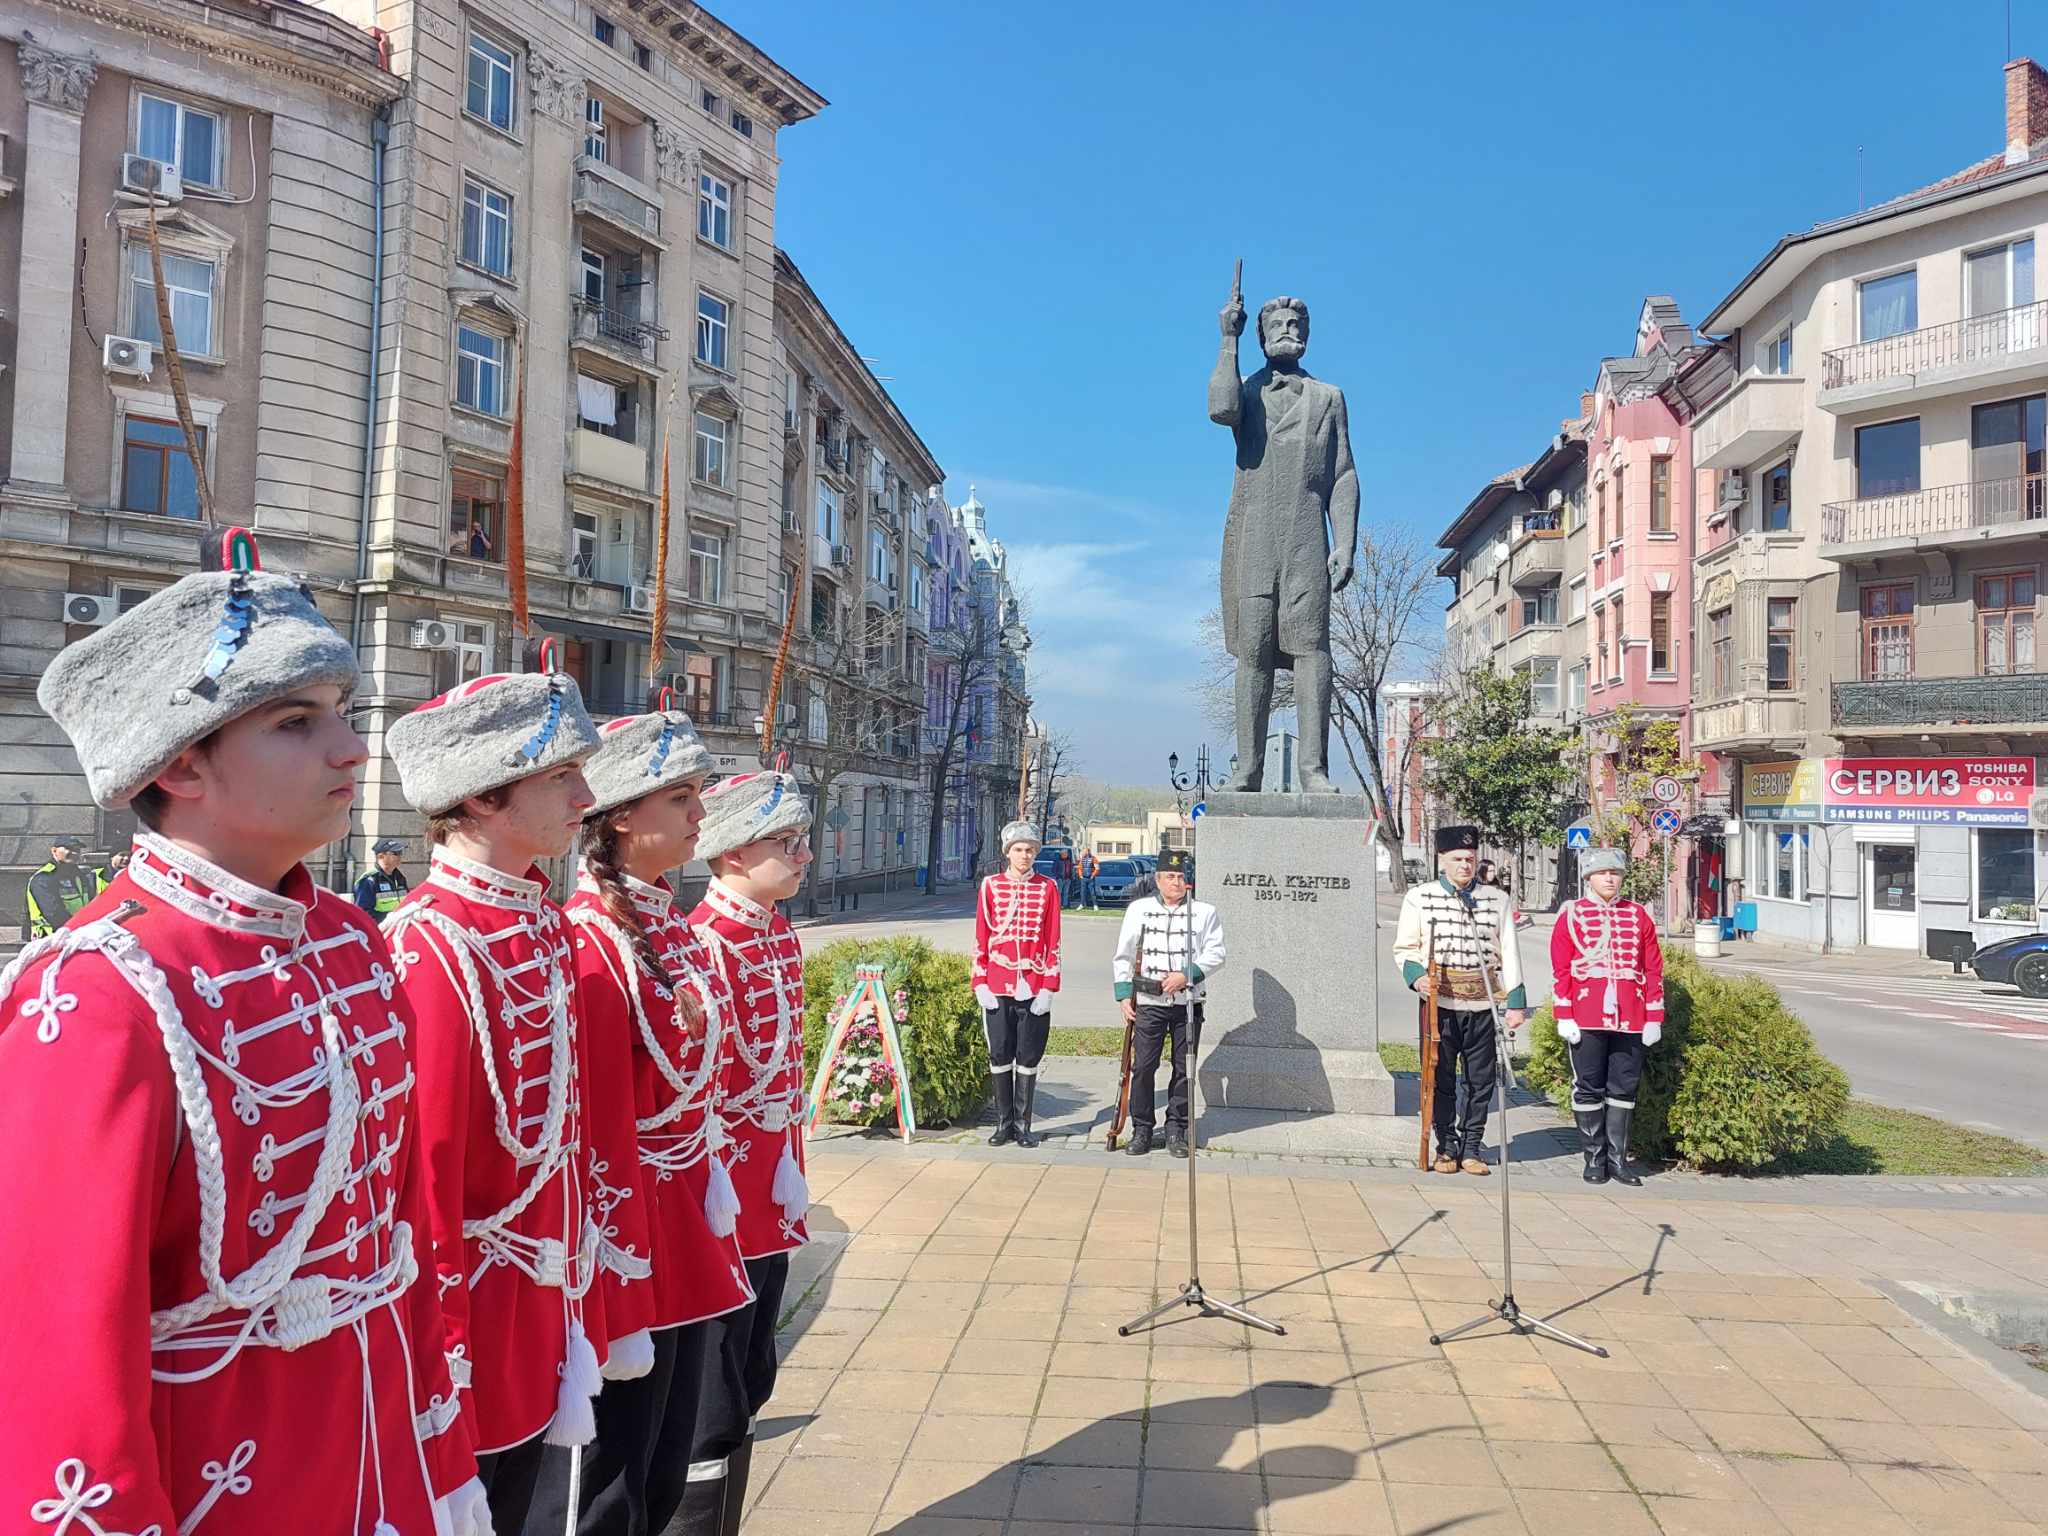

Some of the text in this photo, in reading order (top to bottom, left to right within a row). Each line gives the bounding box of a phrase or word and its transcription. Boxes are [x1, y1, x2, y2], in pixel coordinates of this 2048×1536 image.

[720, 757, 737, 766] БРП
[1965, 763, 2028, 773] TOSHIBA
[1751, 771, 1793, 797] СЕРВИЗ
[1829, 769, 1961, 796] СЕРВИЗ
[1968, 776, 2025, 786] SONY
[1658, 783, 1676, 797] 30
[1830, 809, 2027, 823] SAMSUNG PHILIPS Panasonic
[1222, 873, 1351, 890] АНГЕЛ КЪНЧЕВ
